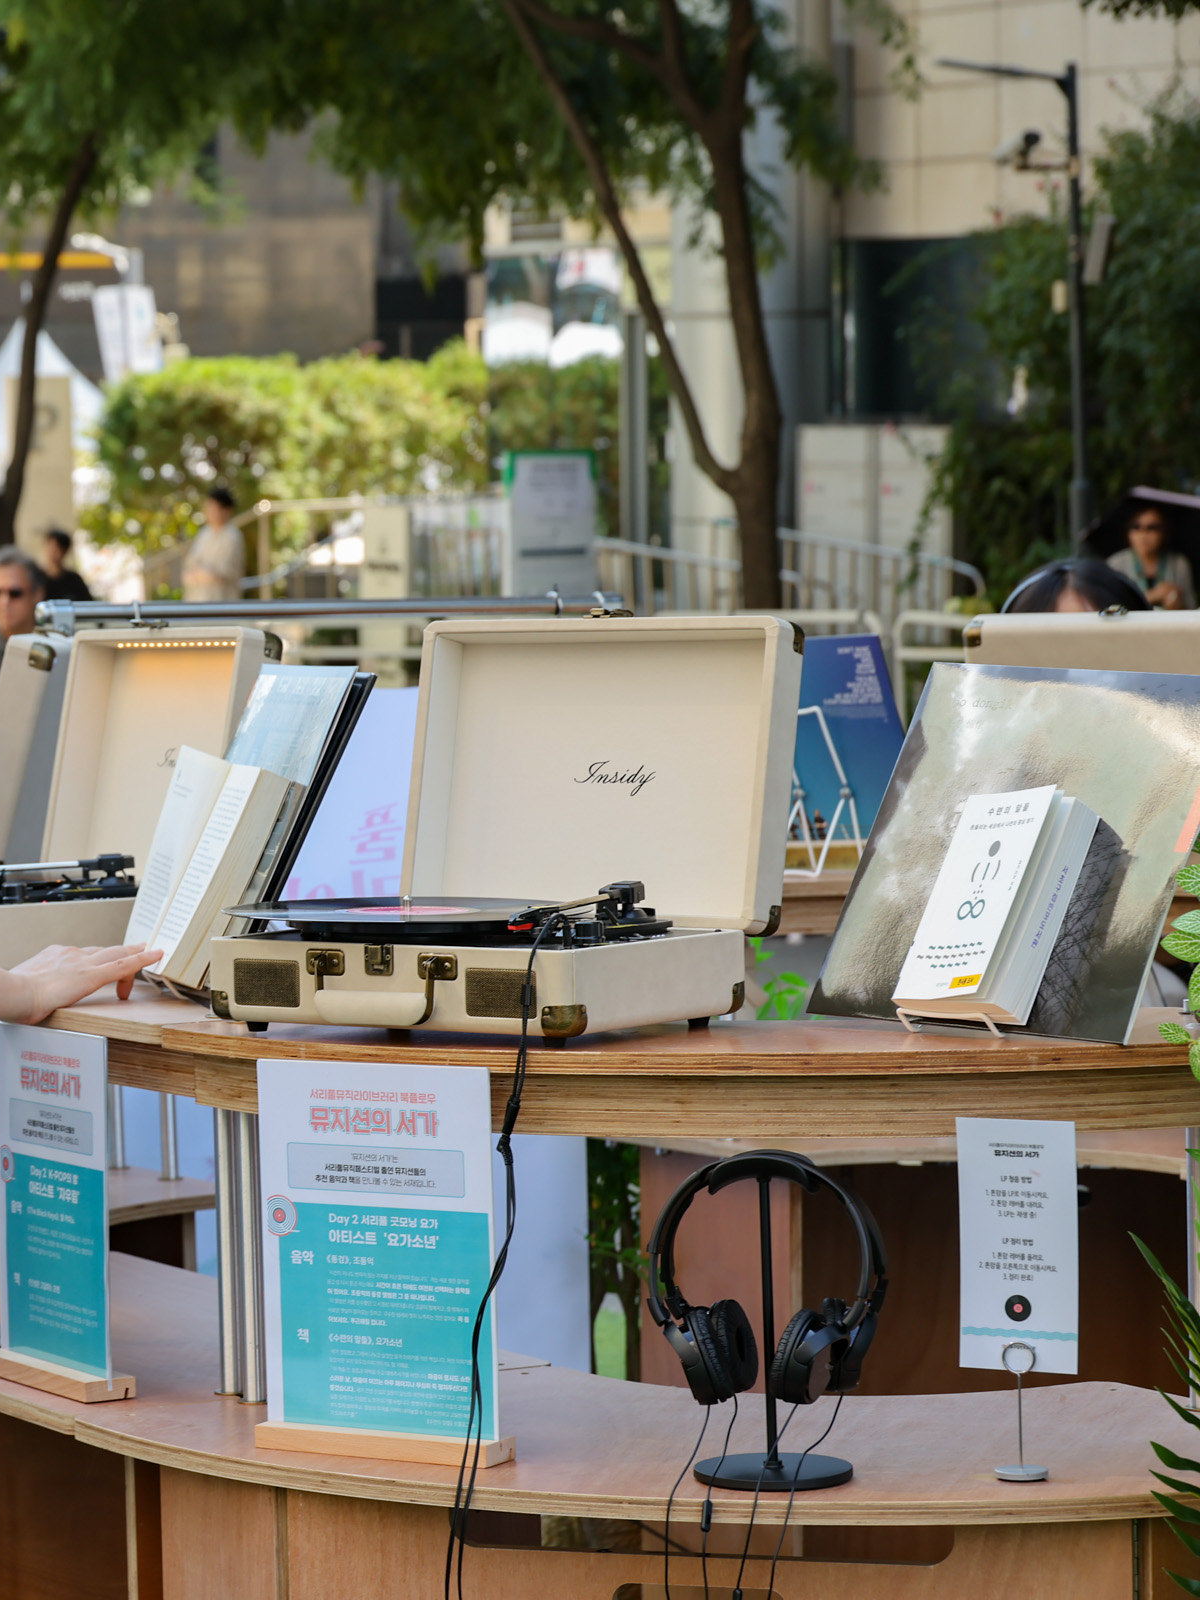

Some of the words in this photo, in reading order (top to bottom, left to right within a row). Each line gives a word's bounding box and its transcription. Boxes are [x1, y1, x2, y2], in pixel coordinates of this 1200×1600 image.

[574, 760, 656, 797] Insidy
[21, 1067, 59, 1095] 뮤지션의
[61, 1073, 81, 1099] 서가
[309, 1088, 398, 1103] 서리풀뮤직라이브러리
[400, 1093, 437, 1105] 북플로우
[309, 1106, 392, 1136] 뮤지션의
[396, 1109, 440, 1138] 서가
[994, 1149, 1023, 1158] 뮤지션의
[30, 1165, 42, 1179] Day
[42, 1167, 47, 1178] 2
[324, 1163, 380, 1174] 서리풀뮤직페스티벌
[381, 1166, 394, 1175] 출연
[394, 1167, 426, 1176] 뮤지션들의
[315, 1174, 328, 1183] 추천
[329, 1175, 347, 1184] 음악과
[390, 1178, 402, 1187] 있는
[29, 1180, 55, 1198] 아티스트
[328, 1212, 350, 1227] Day
[352, 1214, 359, 1225] 2
[361, 1215, 388, 1227] 서리풀
[390, 1216, 417, 1228] 굿모닝
[420, 1218, 438, 1230] 요가
[328, 1229, 377, 1245] 아티스트
[383, 1232, 439, 1249] '요가소년'
[290, 1249, 314, 1265] 음악
[353, 1256, 374, 1266] 조동익
[297, 1328, 310, 1343] 책
[376, 1337, 403, 1348] 요가소년
